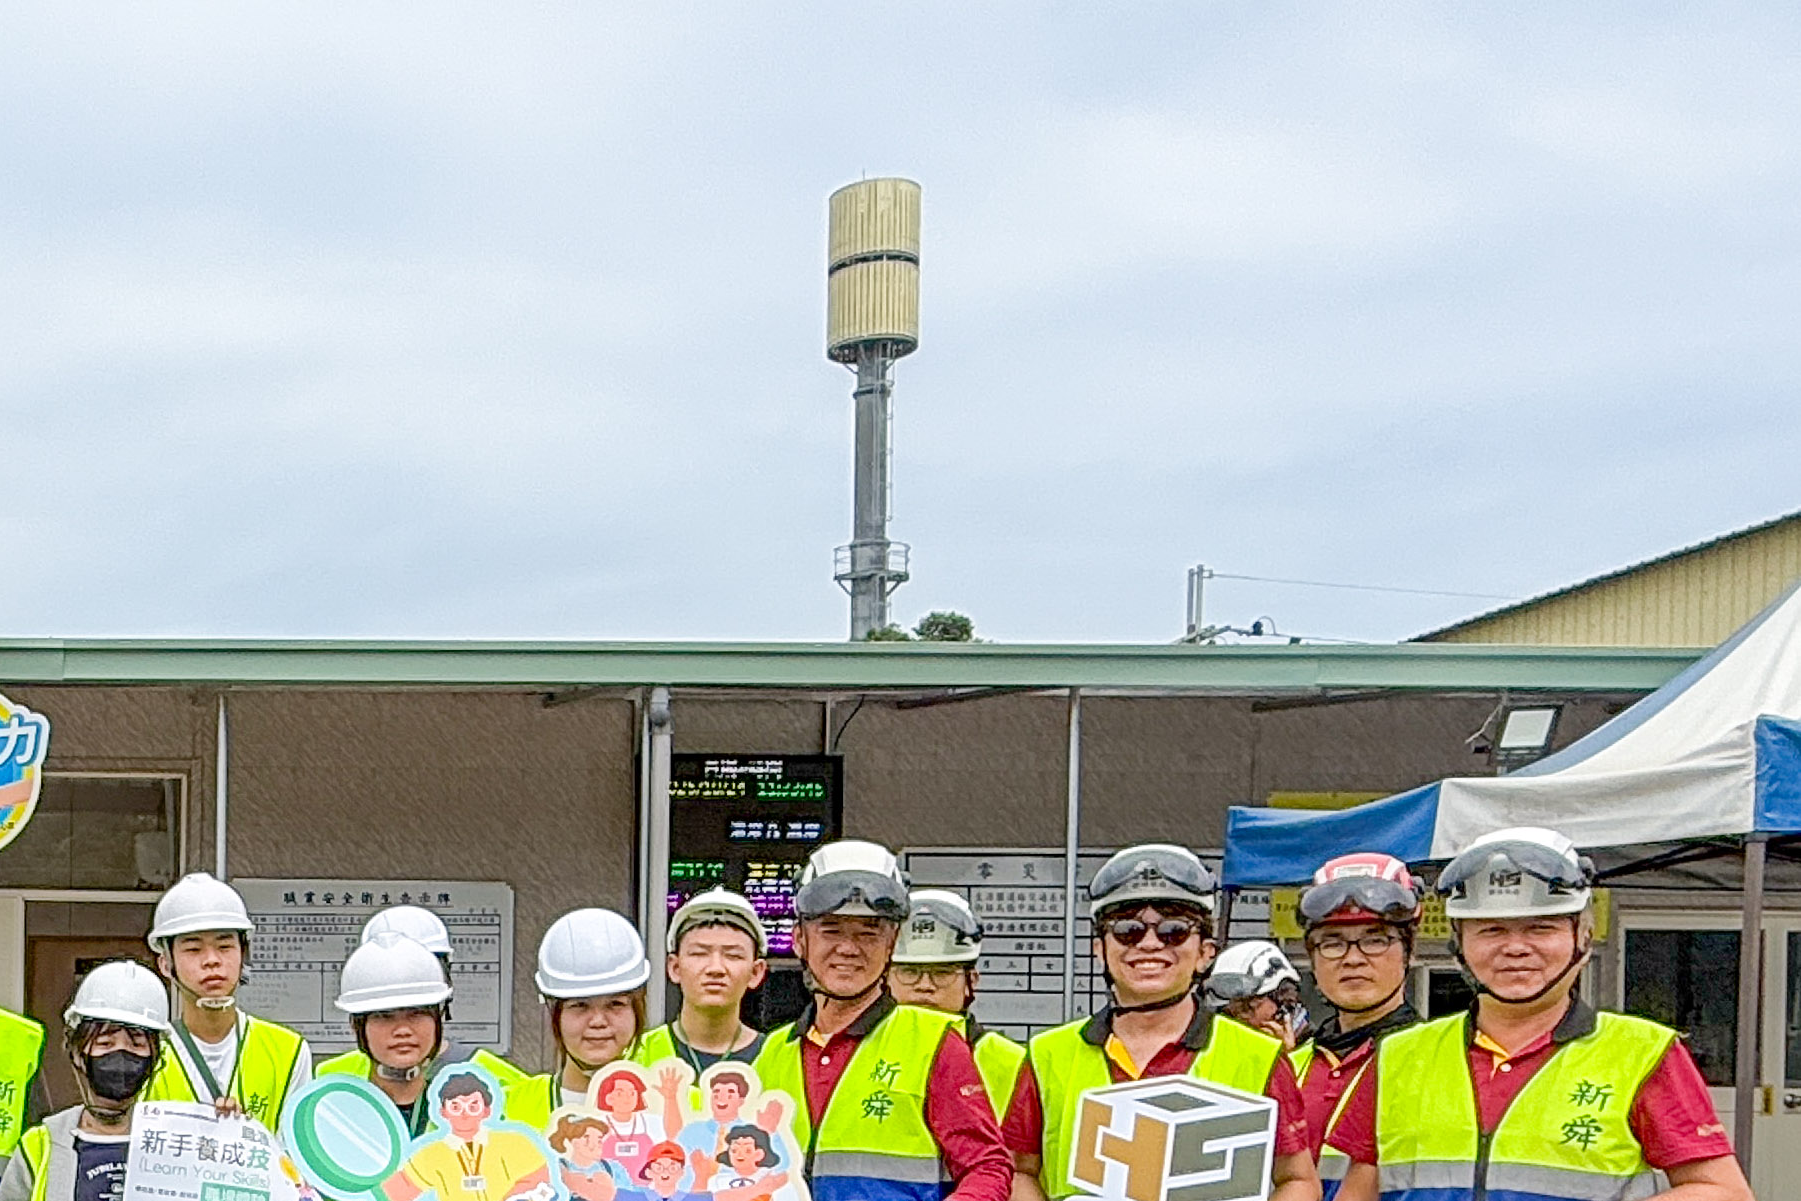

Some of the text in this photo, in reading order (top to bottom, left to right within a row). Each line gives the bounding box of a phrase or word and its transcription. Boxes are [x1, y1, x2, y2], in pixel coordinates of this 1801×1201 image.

[860, 1058, 901, 1125] 新舜
[1559, 1079, 1614, 1152] 新舜
[138, 1157, 188, 1177] (Learn
[192, 1166, 228, 1182] Your
[140, 1128, 272, 1171] 新手養成技
